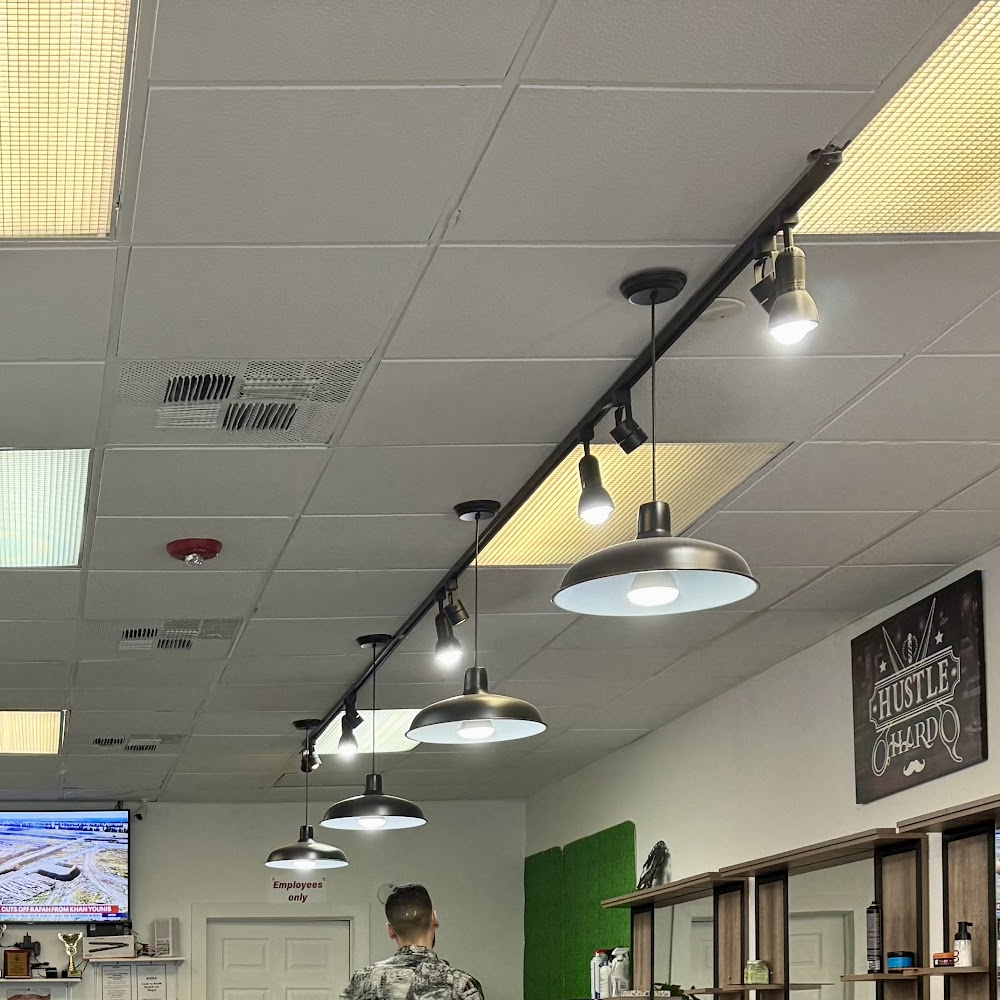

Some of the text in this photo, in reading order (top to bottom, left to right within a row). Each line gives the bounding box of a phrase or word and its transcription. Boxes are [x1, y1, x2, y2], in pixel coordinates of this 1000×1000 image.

[877, 658, 950, 720] HUSTLE
[889, 716, 939, 758] HARD
[273, 880, 323, 890] Employees
[288, 893, 308, 903] only
